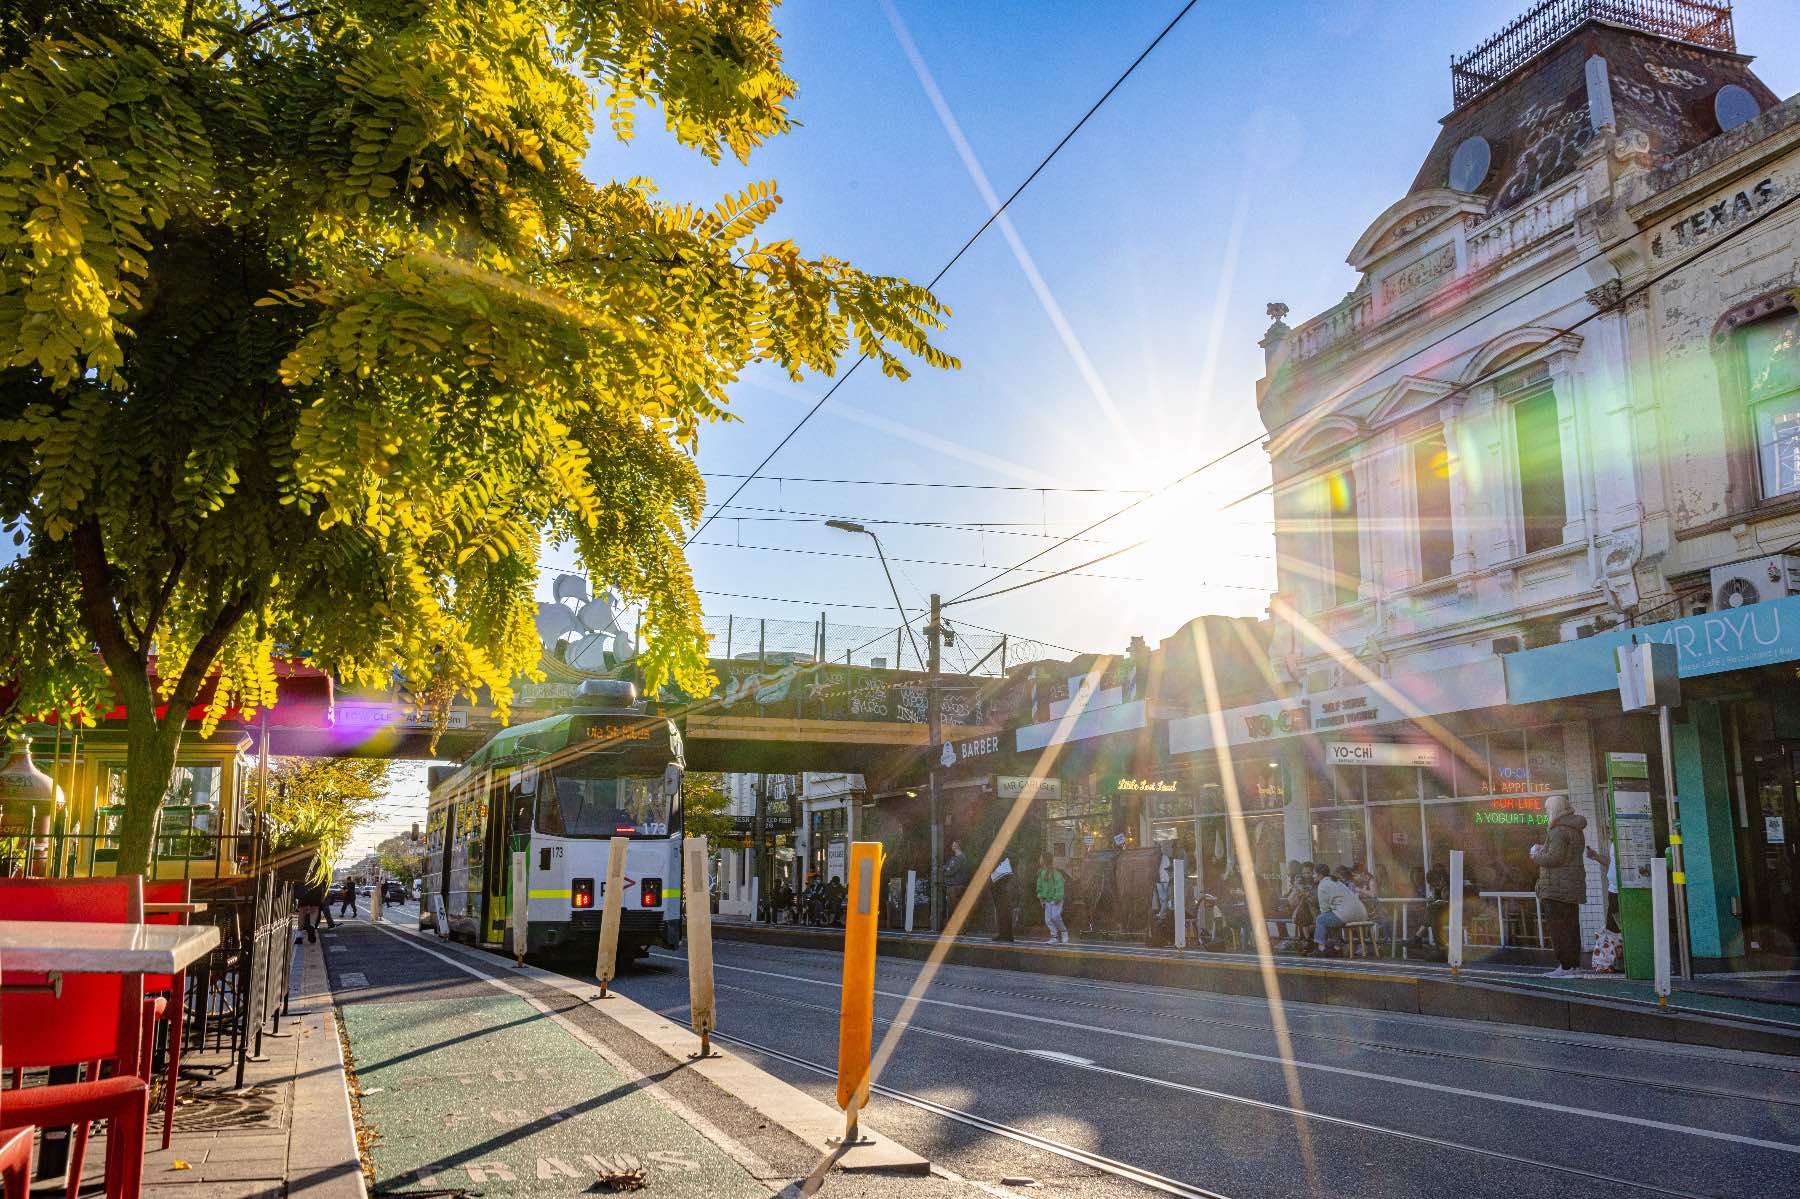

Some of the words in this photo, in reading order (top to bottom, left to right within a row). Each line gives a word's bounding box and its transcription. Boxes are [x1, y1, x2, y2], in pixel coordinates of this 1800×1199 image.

[1670, 178, 1771, 241] TEXAS
[961, 736, 999, 759] BARBER
[1484, 813, 1525, 824] YOGURT
[1536, 815, 1550, 825] DA
[642, 823, 667, 834] 173
[551, 847, 564, 859] 173
